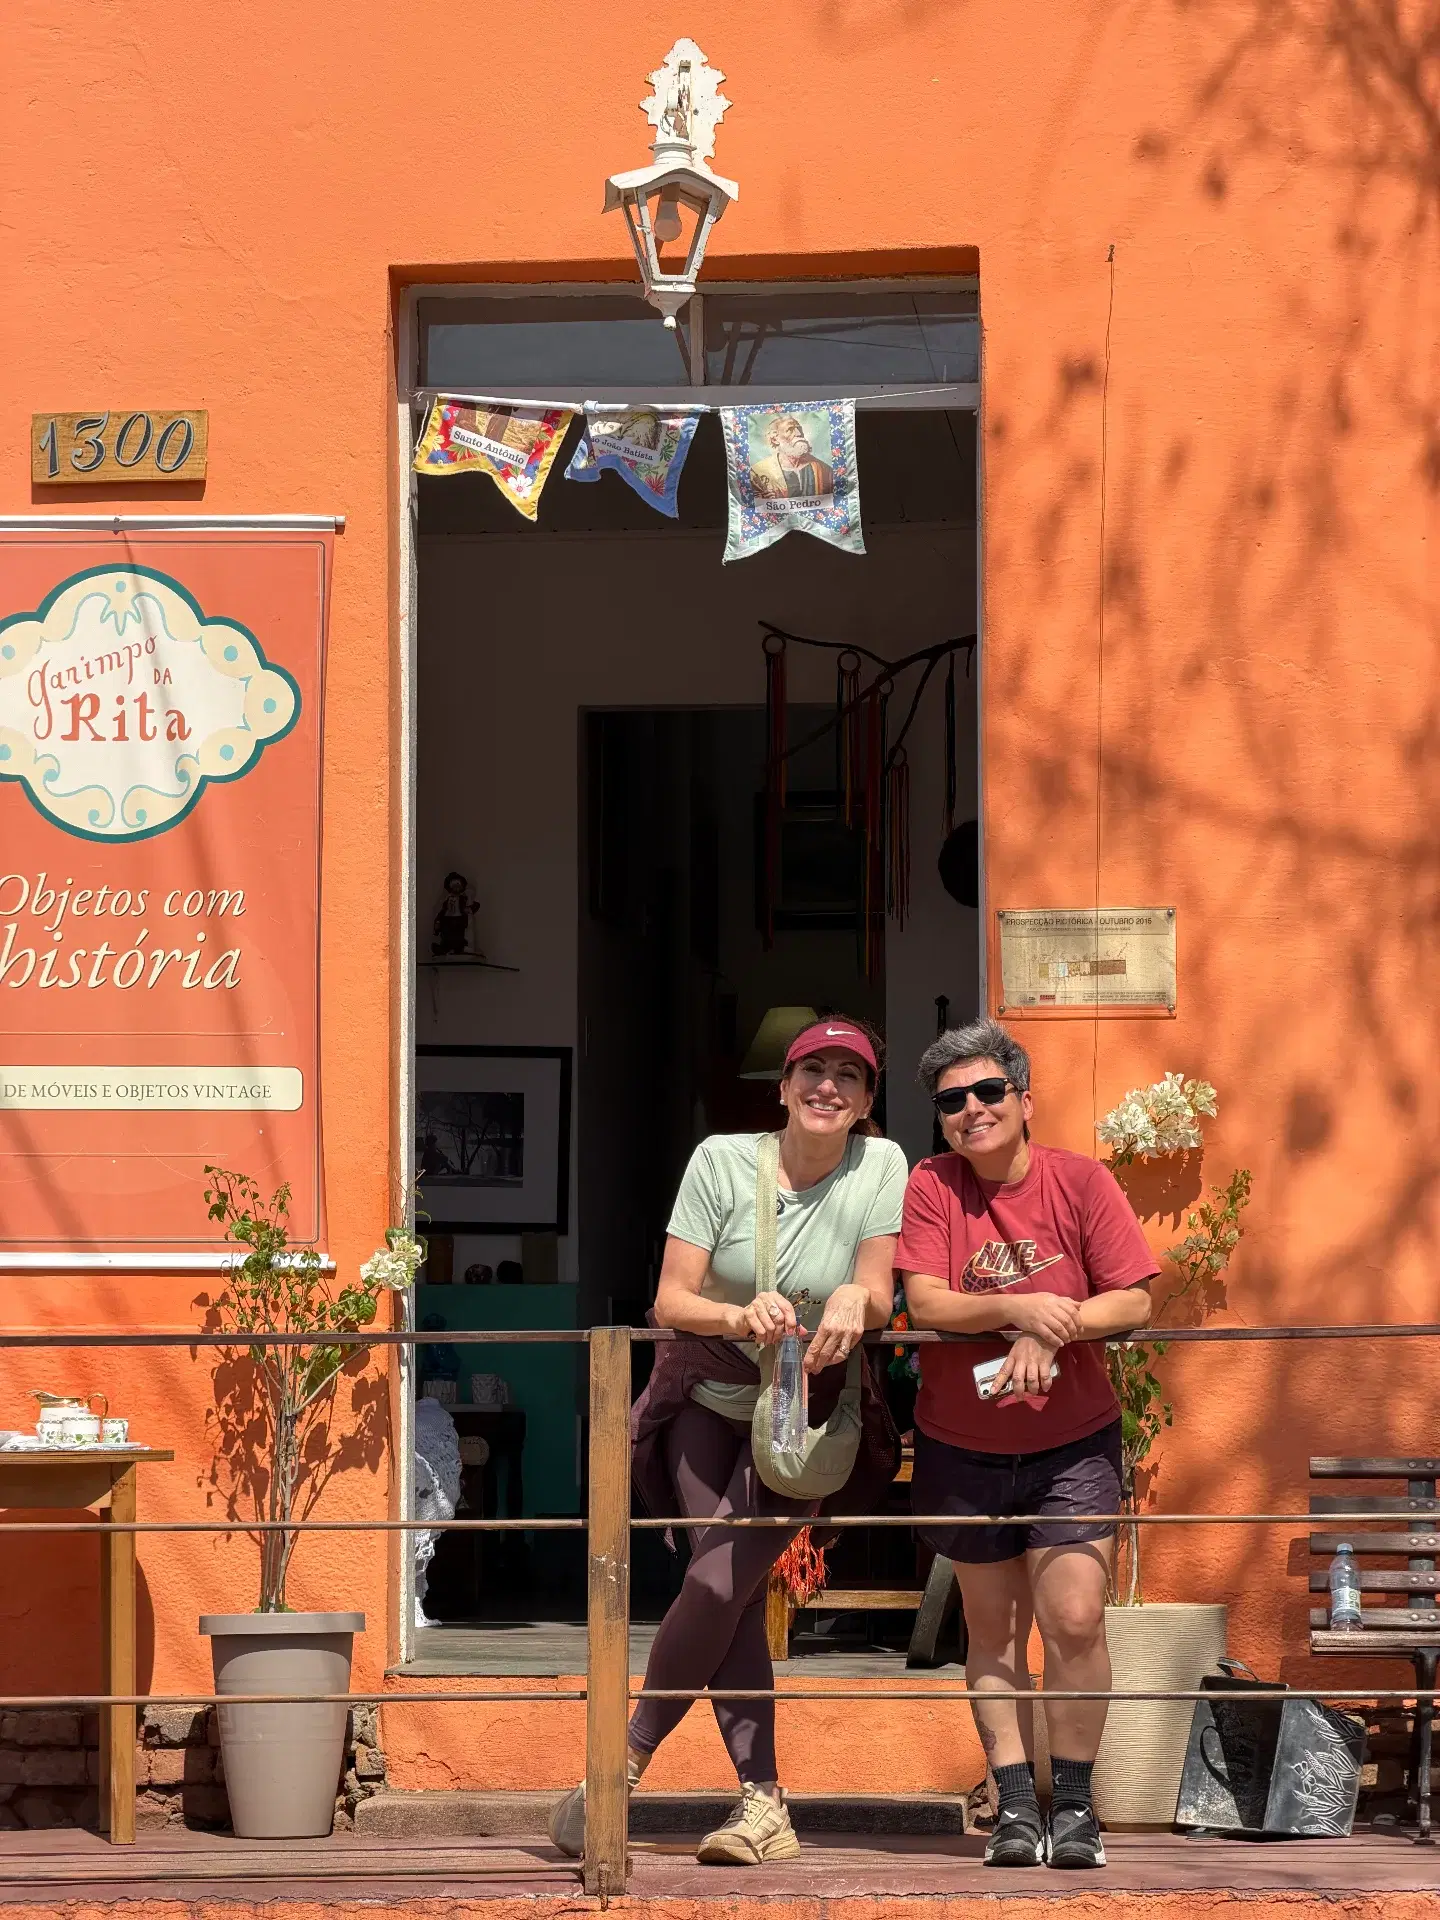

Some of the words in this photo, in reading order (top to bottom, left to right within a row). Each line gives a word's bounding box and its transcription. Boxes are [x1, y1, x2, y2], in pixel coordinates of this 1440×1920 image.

[39, 410, 195, 477] 1300
[453, 430, 483, 448] Santo
[484, 442, 525, 465] Antônio
[601, 440, 622, 451] João
[622, 446, 654, 461] Batista
[765, 501, 786, 511] São
[789, 499, 822, 510] Pedro
[153, 667, 173, 685] DA
[60, 690, 192, 742] Rita
[0, 872, 150, 932] Objetos
[163, 889, 246, 917] com
[1099, 917, 1135, 925] OUTUBRO
[0, 922, 242, 989] história
[4, 1084, 27, 1098] DE
[31, 1081, 98, 1098] MÓVEIS
[102, 1084, 112, 1098] E
[115, 1084, 189, 1101] OBJETOS
[193, 1084, 272, 1099] VINTAGE
[973, 1239, 1038, 1276] NIKE
